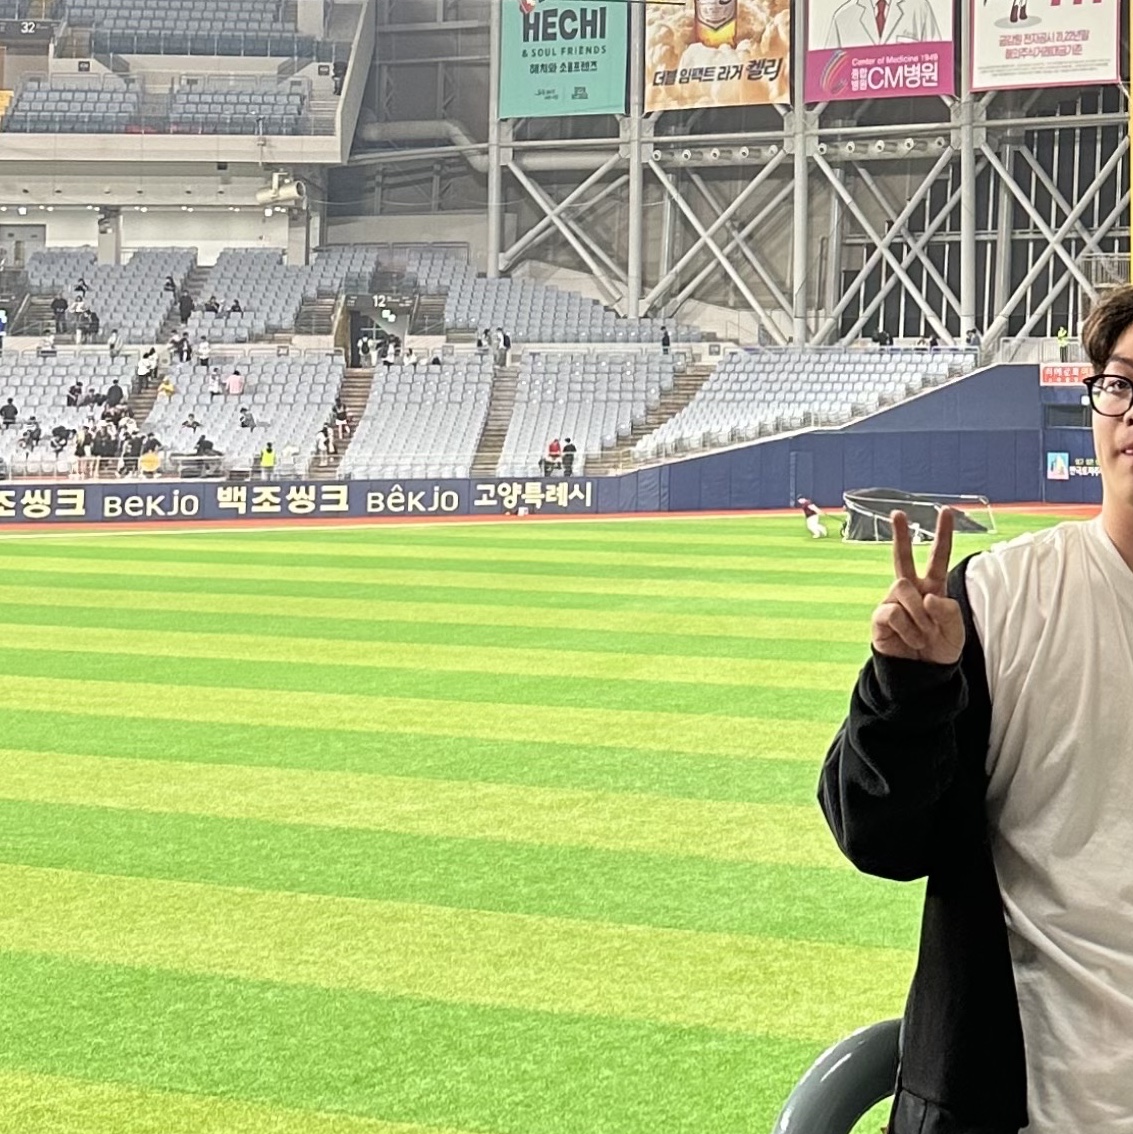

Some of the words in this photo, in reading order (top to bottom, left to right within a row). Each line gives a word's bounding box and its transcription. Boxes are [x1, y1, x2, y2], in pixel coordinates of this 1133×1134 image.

[20, 21, 36, 34] 32
[522, 6, 607, 42] HECHI
[531, 47, 558, 57] SOUL
[561, 45, 607, 55] FRIENDS
[877, 56, 885, 64] of
[652, 69, 678, 87] 더블
[717, 64, 744, 81] 라거
[745, 57, 784, 82] 켈리
[868, 61, 939, 91] CM병원
[372, 294, 386, 308] 12
[216, 485, 349, 515] 백조씽크
[474, 481, 592, 509] 고양특례시
